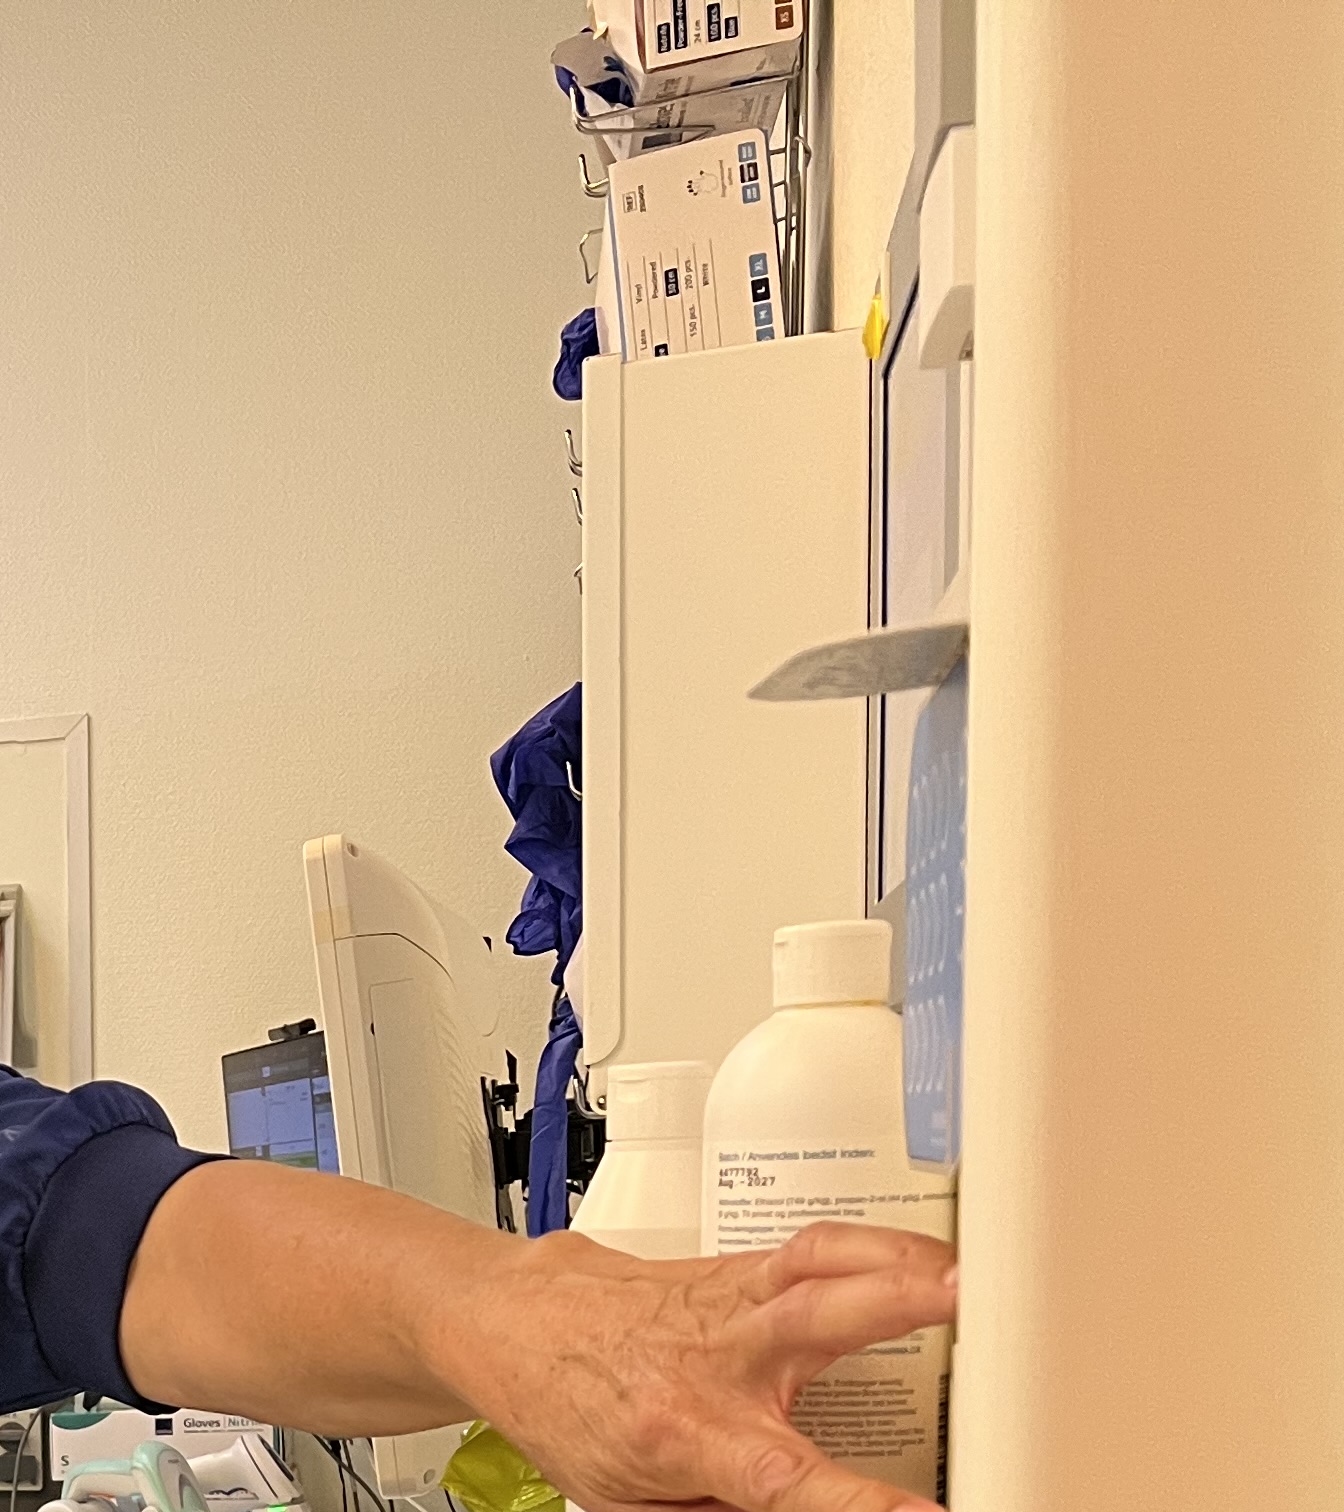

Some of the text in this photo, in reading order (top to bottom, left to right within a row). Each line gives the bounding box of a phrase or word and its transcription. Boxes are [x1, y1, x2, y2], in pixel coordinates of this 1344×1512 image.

[747, 1176, 776, 1187] 2027
[183, 1417, 221, 1428] Gloves
[60, 1454, 70, 1467] S
